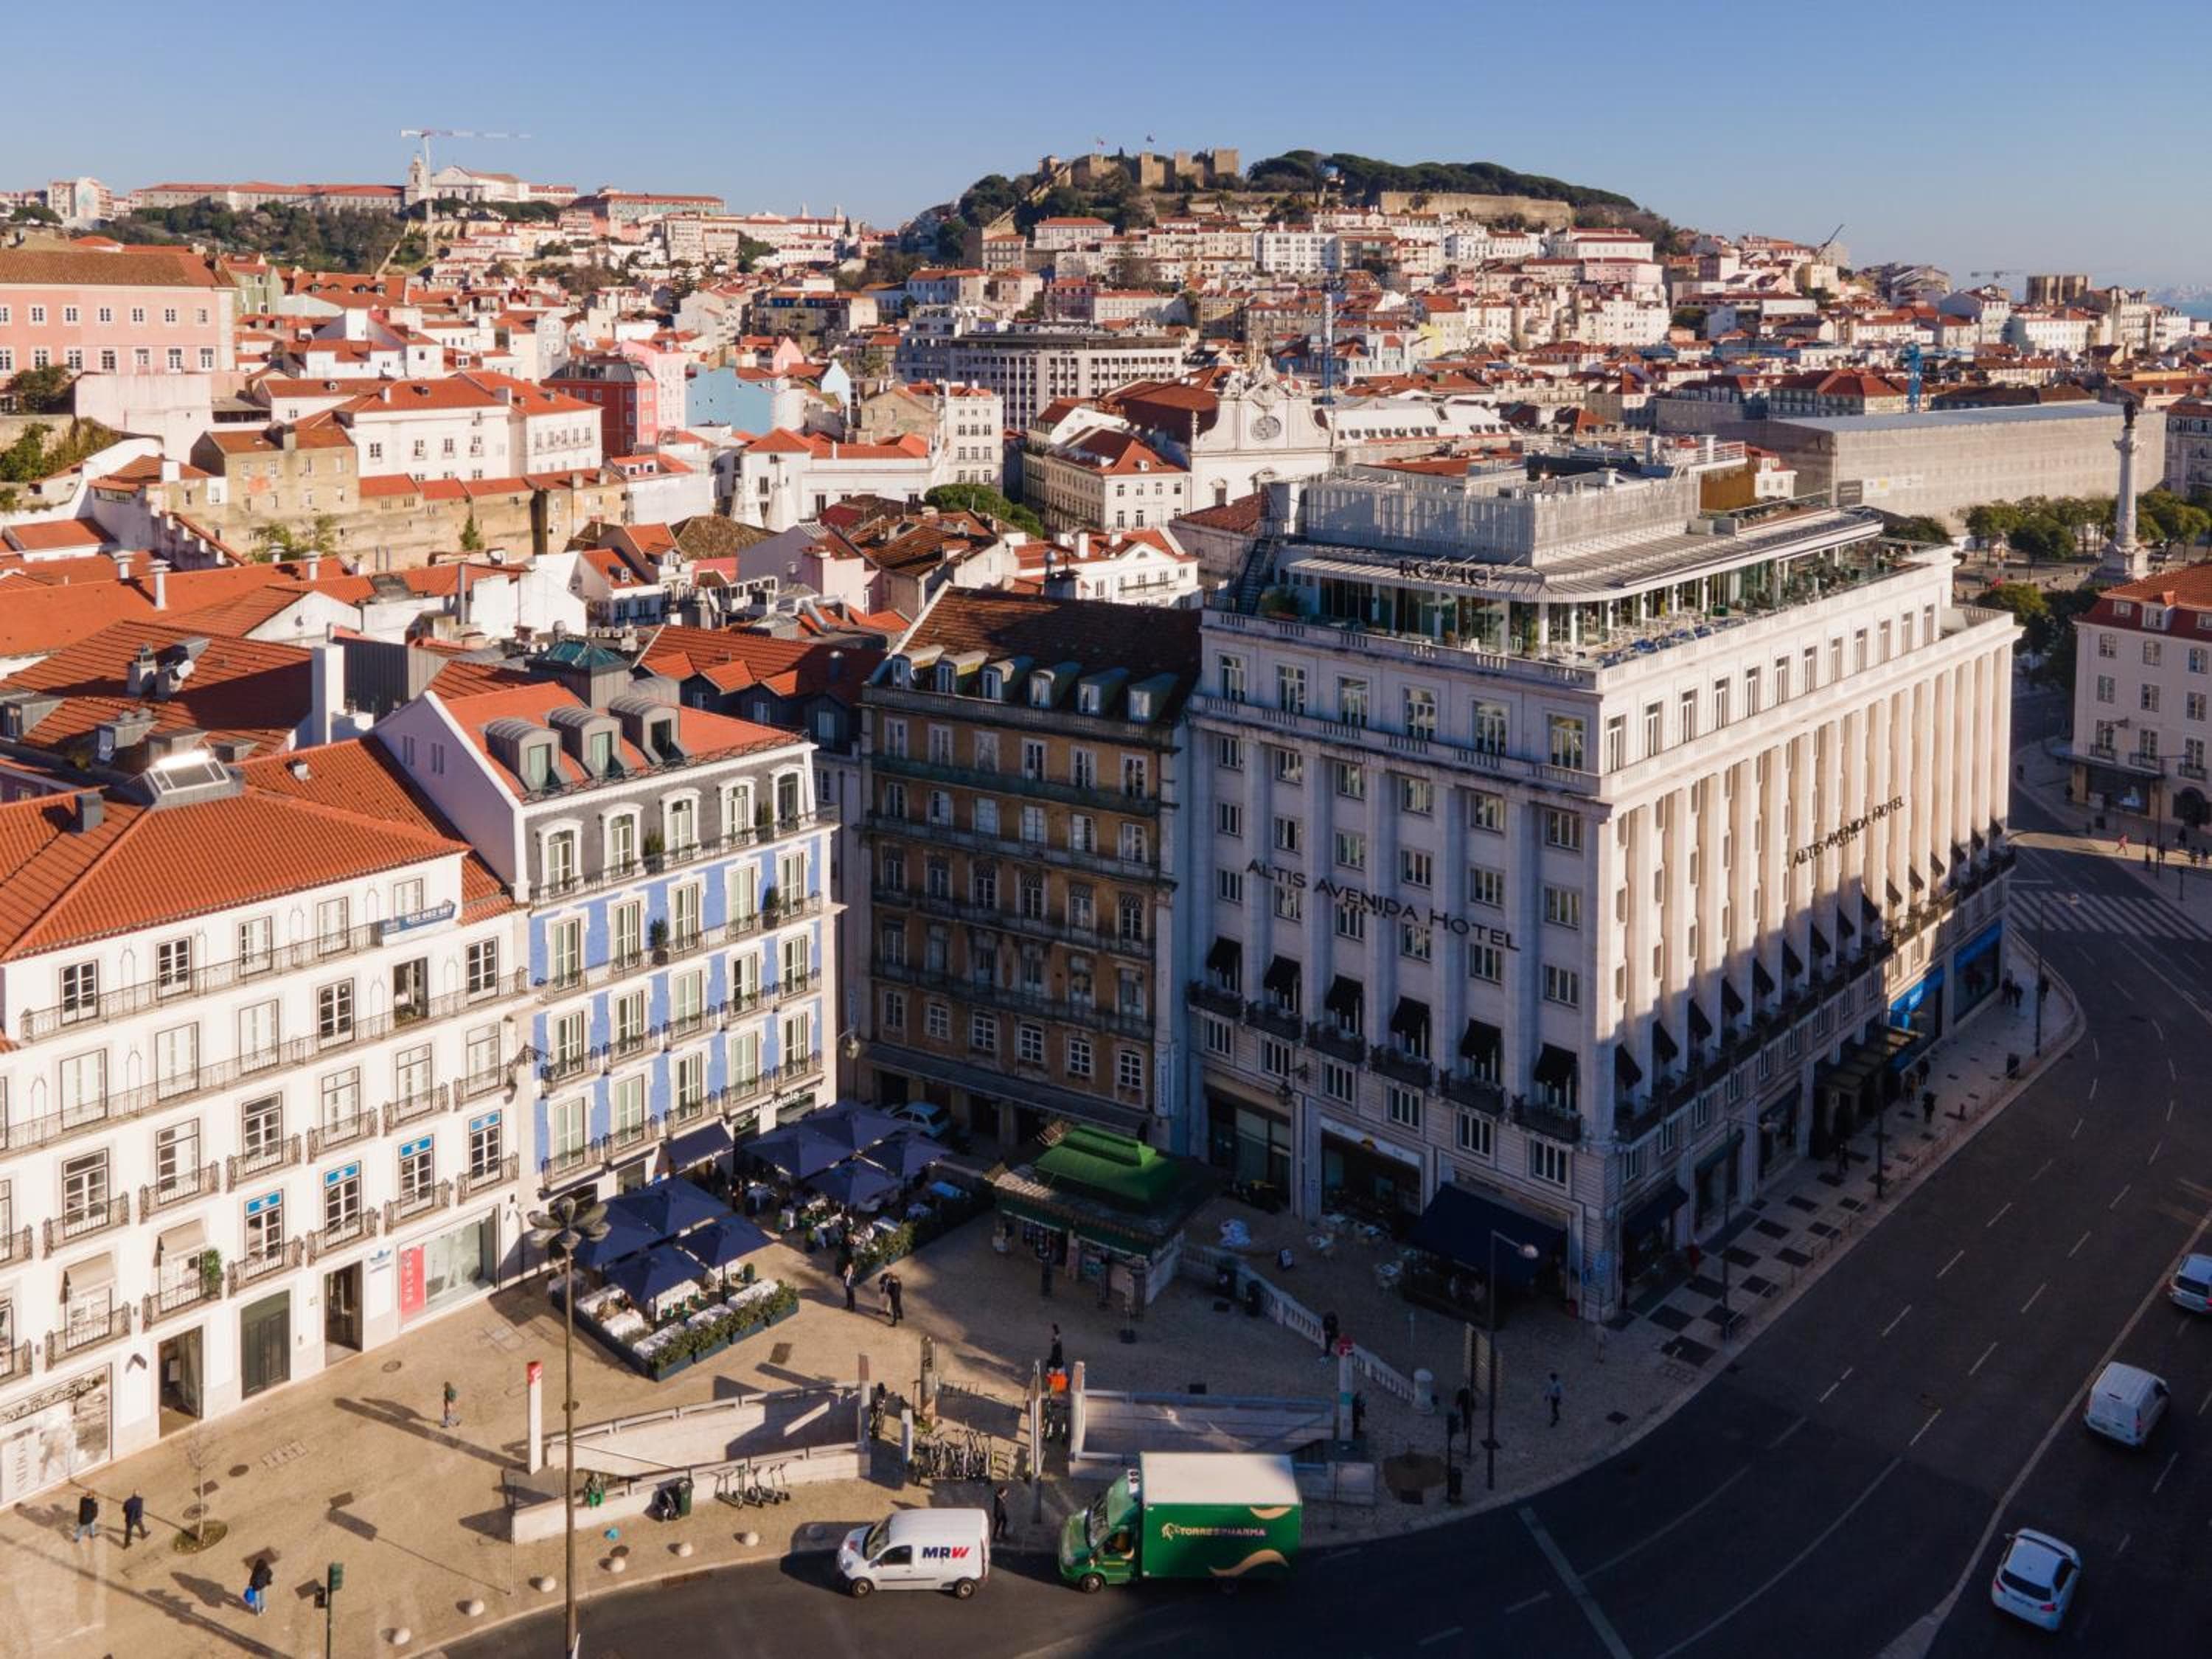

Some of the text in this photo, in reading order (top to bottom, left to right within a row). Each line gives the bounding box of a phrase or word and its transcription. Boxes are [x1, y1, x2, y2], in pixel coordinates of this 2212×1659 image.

[1245, 858, 1521, 951] ALTIS AVENIDA HOTEL
[922, 1546, 970, 1559] MRW
